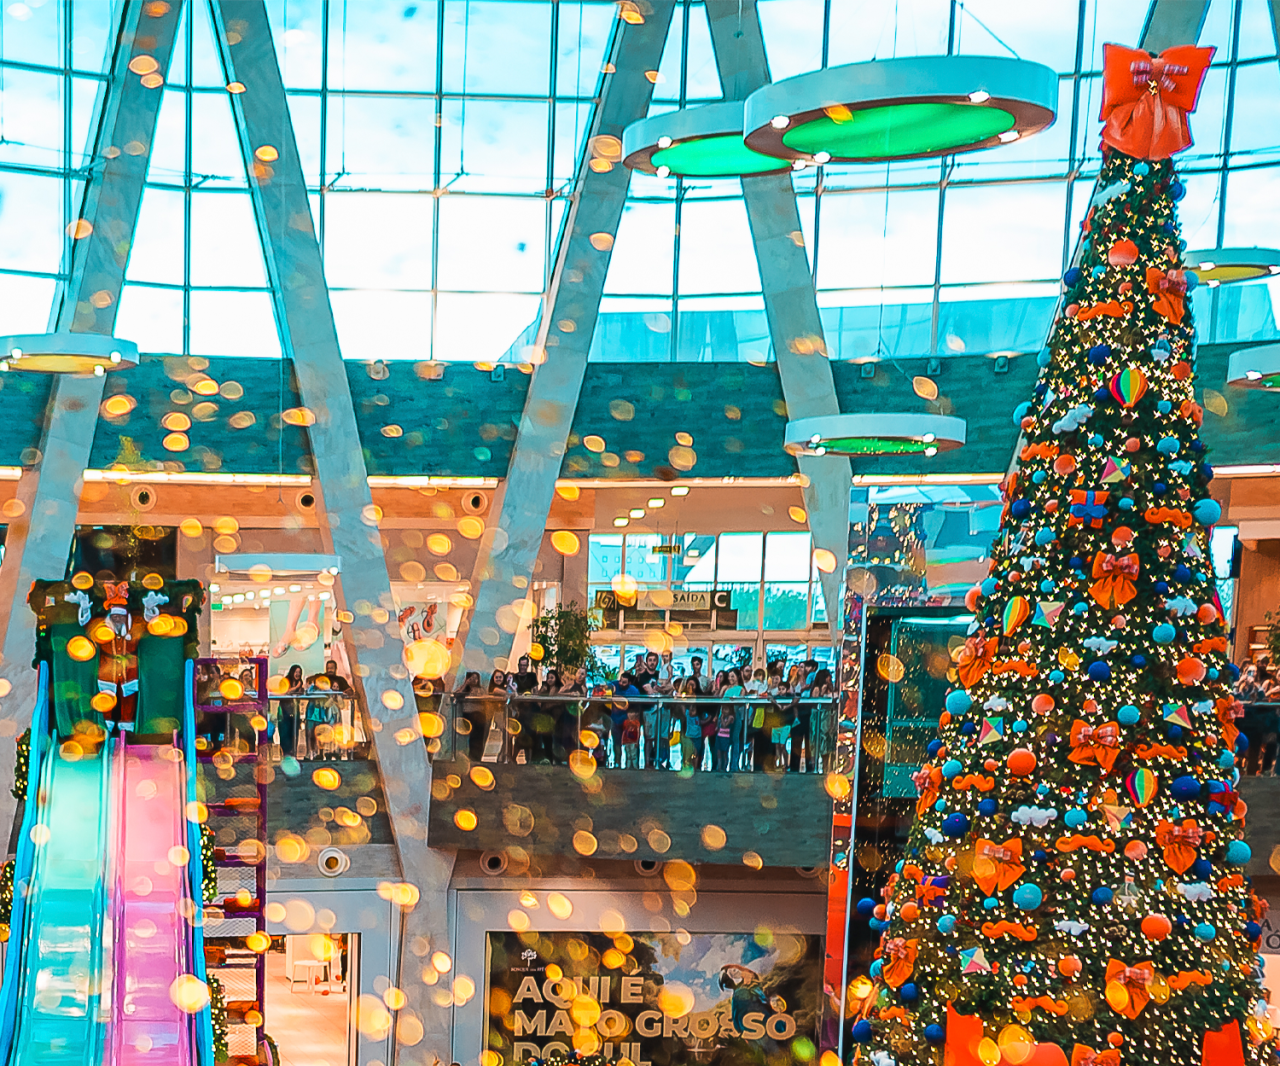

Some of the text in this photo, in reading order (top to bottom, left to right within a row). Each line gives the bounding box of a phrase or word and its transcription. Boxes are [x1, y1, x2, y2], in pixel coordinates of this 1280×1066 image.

[673, 593, 706, 603] SAÍDA
[714, 592, 727, 608] C
[512, 967, 644, 1009] AQUI É
[513, 1010, 797, 1041] MATO GROSSO
